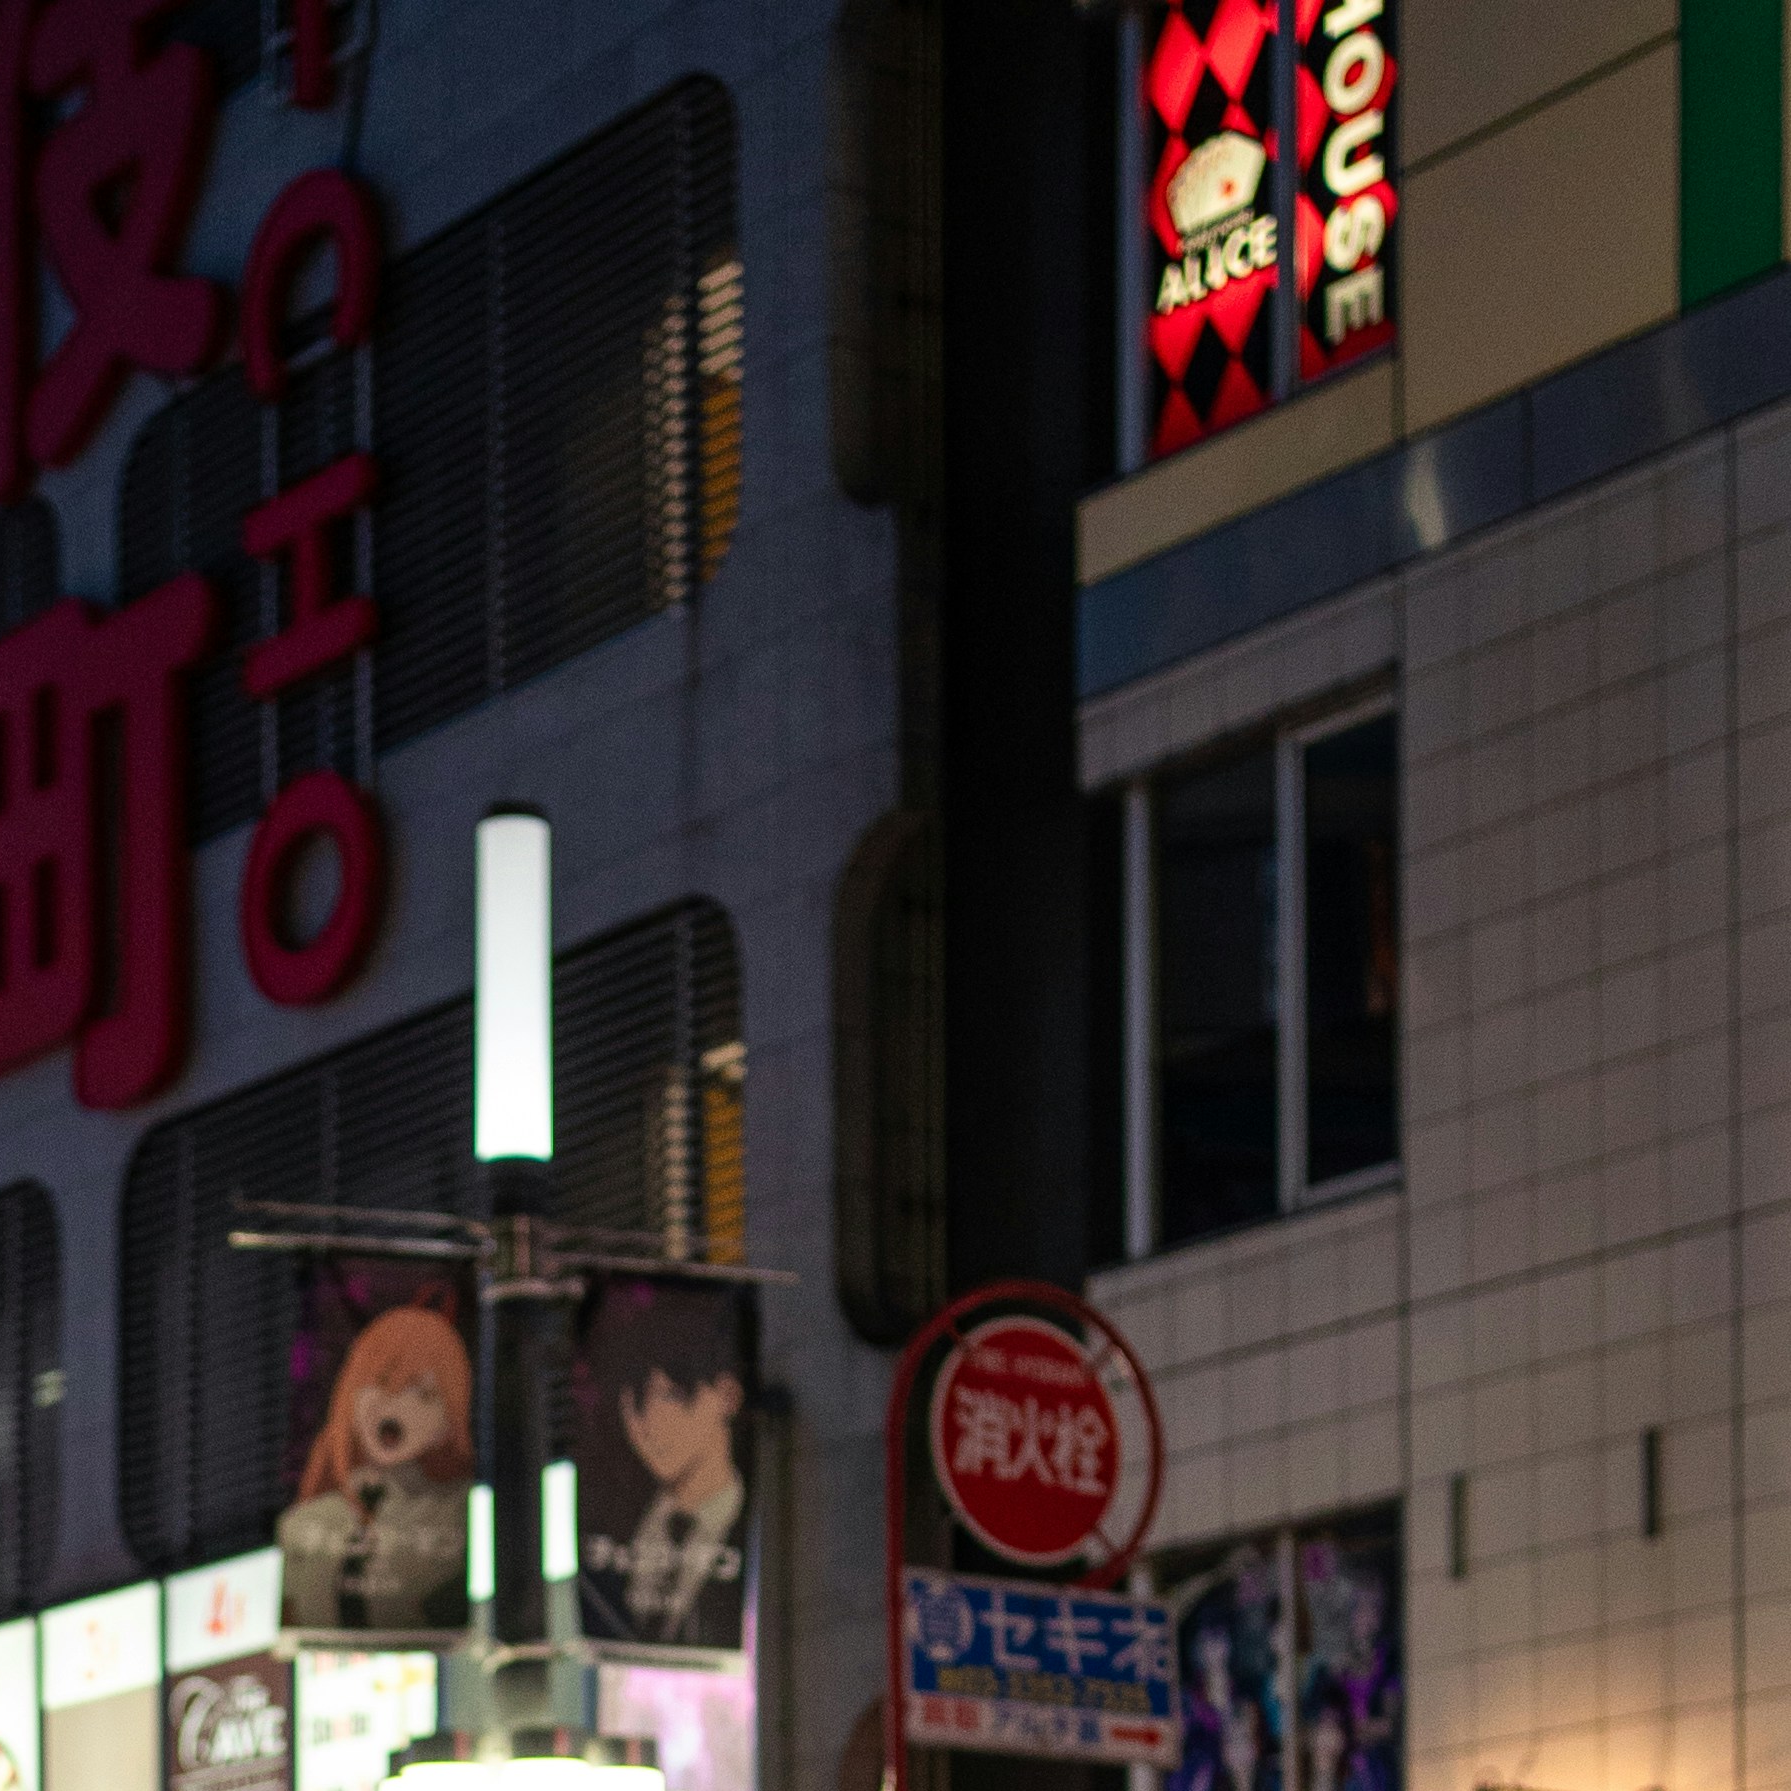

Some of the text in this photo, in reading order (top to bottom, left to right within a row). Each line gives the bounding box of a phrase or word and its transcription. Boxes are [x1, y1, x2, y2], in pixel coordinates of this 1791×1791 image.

[1155, 212, 1278, 316] ALICE
[951, 1383, 1109, 1498] 消火栓
